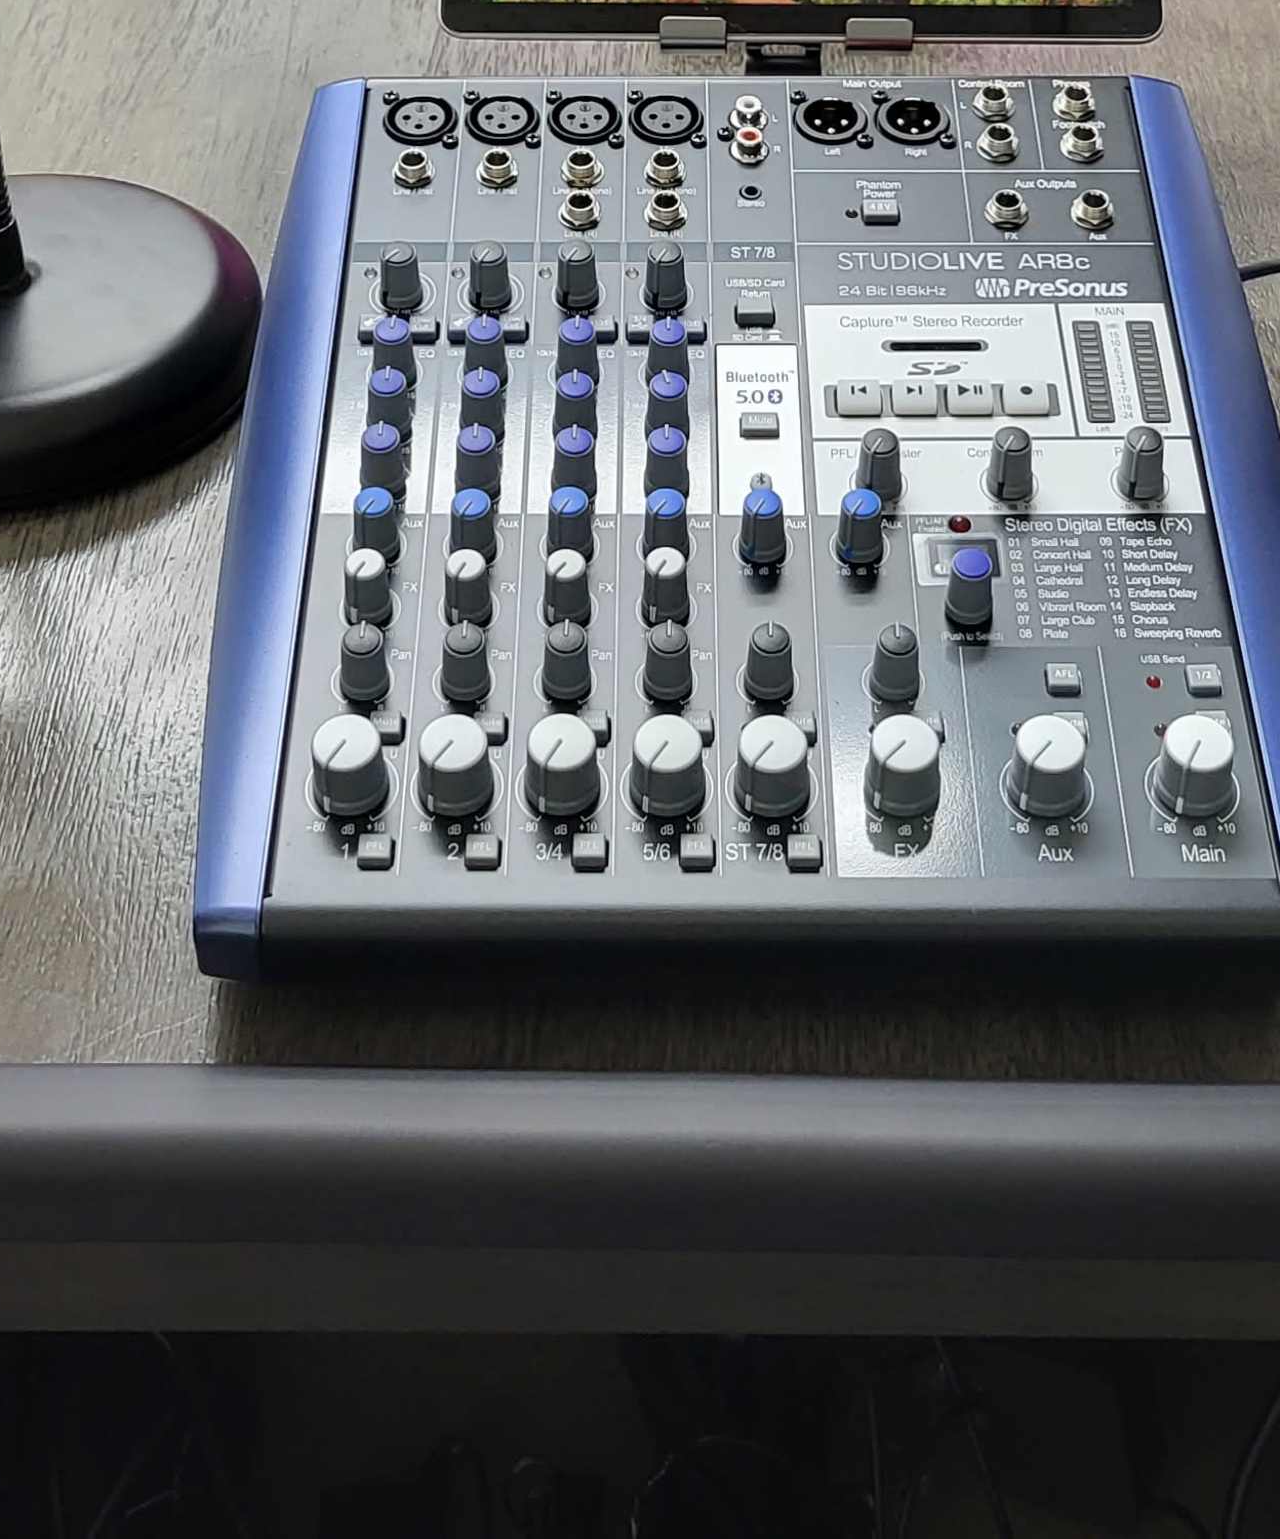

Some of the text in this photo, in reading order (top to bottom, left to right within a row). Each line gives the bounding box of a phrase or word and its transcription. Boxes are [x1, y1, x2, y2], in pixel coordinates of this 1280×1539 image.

[842, 79, 902, 89] Main Output
[855, 180, 902, 189] Phantom
[1014, 180, 1077, 190] Aux Outputs
[863, 189, 897, 198] Power
[1004, 231, 1019, 240] FX
[730, 246, 777, 259] ST 7/8
[838, 252, 1091, 270] STUDIOLIVE AR8c
[839, 285, 861, 296] 24
[1014, 278, 1128, 297] PreSonus
[1094, 307, 1125, 316] MAIN
[913, 315, 958, 328] Stereo
[961, 315, 1023, 328] Recorder
[418, 350, 436, 358] EQ
[509, 350, 525, 358] EQ
[599, 350, 615, 358] EQ
[688, 350, 705, 358] EQ
[736, 389, 764, 404] 5.0
[401, 518, 424, 528] Aux
[497, 518, 520, 528] Aux
[593, 518, 615, 528] Aux
[689, 518, 711, 528] Aux
[785, 519, 807, 529] Aux
[881, 519, 903, 529] Aux
[1005, 517, 1193, 535] Stereo Digital Effects (FX)
[1031, 537, 1058, 546] Small
[1060, 537, 1080, 546] Hall
[1120, 537, 1145, 547] Tape
[1147, 537, 1172, 546] Echo
[1032, 550, 1071, 559] Concert
[1073, 550, 1092, 559] Hall
[1122, 549, 1148, 558] Short
[1150, 549, 1178, 560] Delay
[1034, 563, 1063, 573] Large
[1064, 563, 1084, 572] Hall
[1123, 562, 1163, 571] Medium
[1165, 562, 1193, 573] Delay
[1036, 576, 1084, 585] Cathedral
[1125, 575, 1151, 586] Long
[1152, 575, 1181, 586] Delay
[402, 582, 418, 593] FX
[500, 582, 516, 593] FX
[598, 582, 614, 593] FX
[696, 582, 712, 593] FX
[1038, 589, 1069, 598] Studio
[1127, 588, 1167, 597] Endless
[1169, 588, 1198, 599] Delay
[1039, 602, 1074, 611] Vibrant
[1076, 602, 1107, 611] Room
[1130, 601, 1176, 612] Slapback
[1041, 615, 1070, 626] Large
[1072, 615, 1096, 624] Club
[1132, 615, 1169, 624] Chorus
[1043, 628, 1069, 637] Plate
[1134, 628, 1184, 639] Sweeping
[1185, 628, 1222, 637] Reverb
[390, 649, 412, 660] Pan
[491, 649, 512, 660] Pan
[592, 649, 613, 660] Pan
[692, 649, 713, 660] Pan
[1140, 654, 1161, 664] USB
[340, 843, 349, 860] 1
[447, 843, 459, 860] 2
[535, 843, 563, 861] 3/4
[643, 843, 671, 861] 5/6
[726, 843, 784, 861] ST 7/8
[1038, 844, 1074, 862] Aux
[1181, 844, 1226, 862] Main
